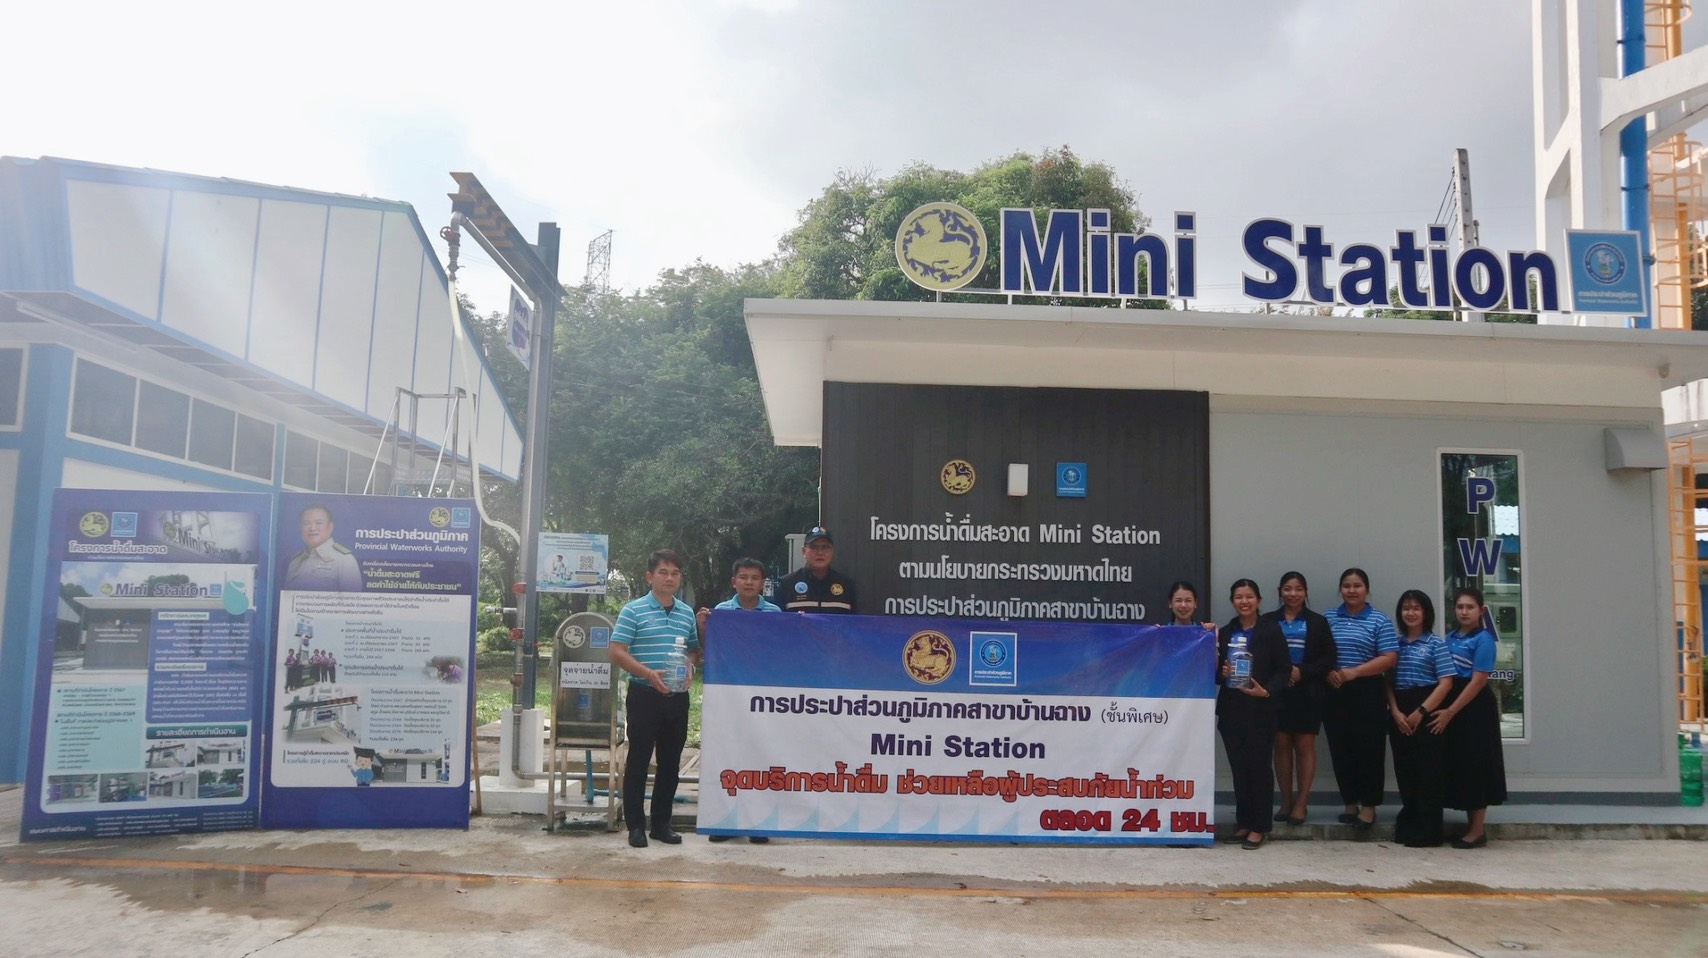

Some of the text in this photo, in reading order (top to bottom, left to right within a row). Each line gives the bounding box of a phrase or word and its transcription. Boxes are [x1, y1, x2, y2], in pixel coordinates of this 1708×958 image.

[1000, 207, 1560, 313] Mini Station
[355, 528, 469, 543] การประปาส่วนภูมิภาค
[870, 512, 1160, 545] โครงการน้ำดื่มสะอาด Mini Station
[69, 540, 167, 554] โครงการน้ำดื่มสะอาด
[354, 542, 468, 555] Provincial Waterworks Authority
[899, 554, 1132, 582] ตามนโยบายกระทรวงมหาดไทย
[115, 582, 208, 597] Mini Station
[884, 593, 1146, 620] การประปาส่วนภูมิภาคสาขาบ้านฉาง
[563, 663, 609, 676] จุดจ่ายน้ำดื่ม
[750, 694, 1169, 724] การประปาส่วนภูมิภาคสาขาบ้านฉาง (ชั้นพิเศษ)
[871, 733, 1045, 759] Mini Station
[720, 761, 1195, 802] จุดบริการน้ำดื่ม ช่วยเหลือผู้ประสบภัยน้ำท่วม
[1039, 808, 1215, 833] ตลอด 24 ชม.
